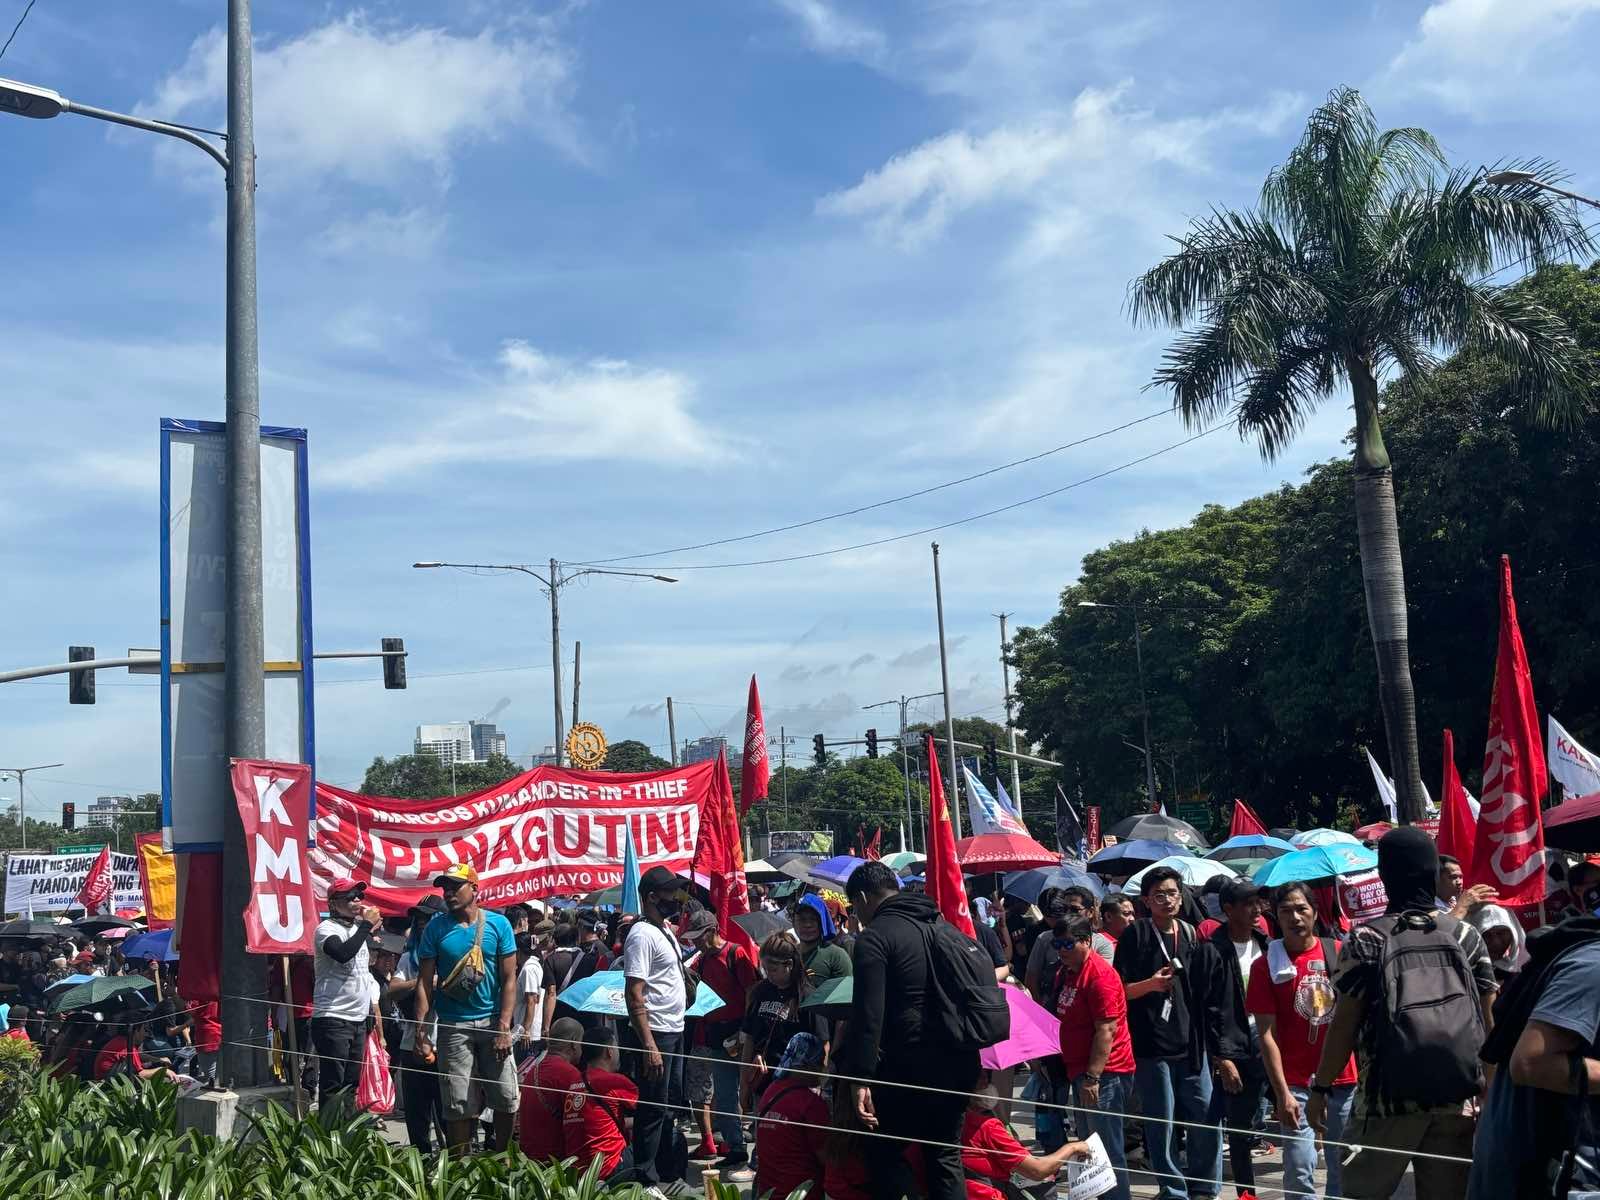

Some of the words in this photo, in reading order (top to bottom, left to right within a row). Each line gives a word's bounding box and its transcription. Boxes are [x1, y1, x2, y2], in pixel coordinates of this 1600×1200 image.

[368, 806, 474, 825] MARCOS
[380, 811, 695, 882] PANAGUTIN!
[9, 858, 48, 876] LAHAT
[50, 860, 63, 871] NG
[113, 855, 139, 871] DAPA
[253, 775, 304, 943] KMU
[541, 872, 592, 888] MAYO
[597, 872, 624, 885] UN
[1360, 891, 1375, 900] DAY
[1376, 888, 1386, 896] OF
